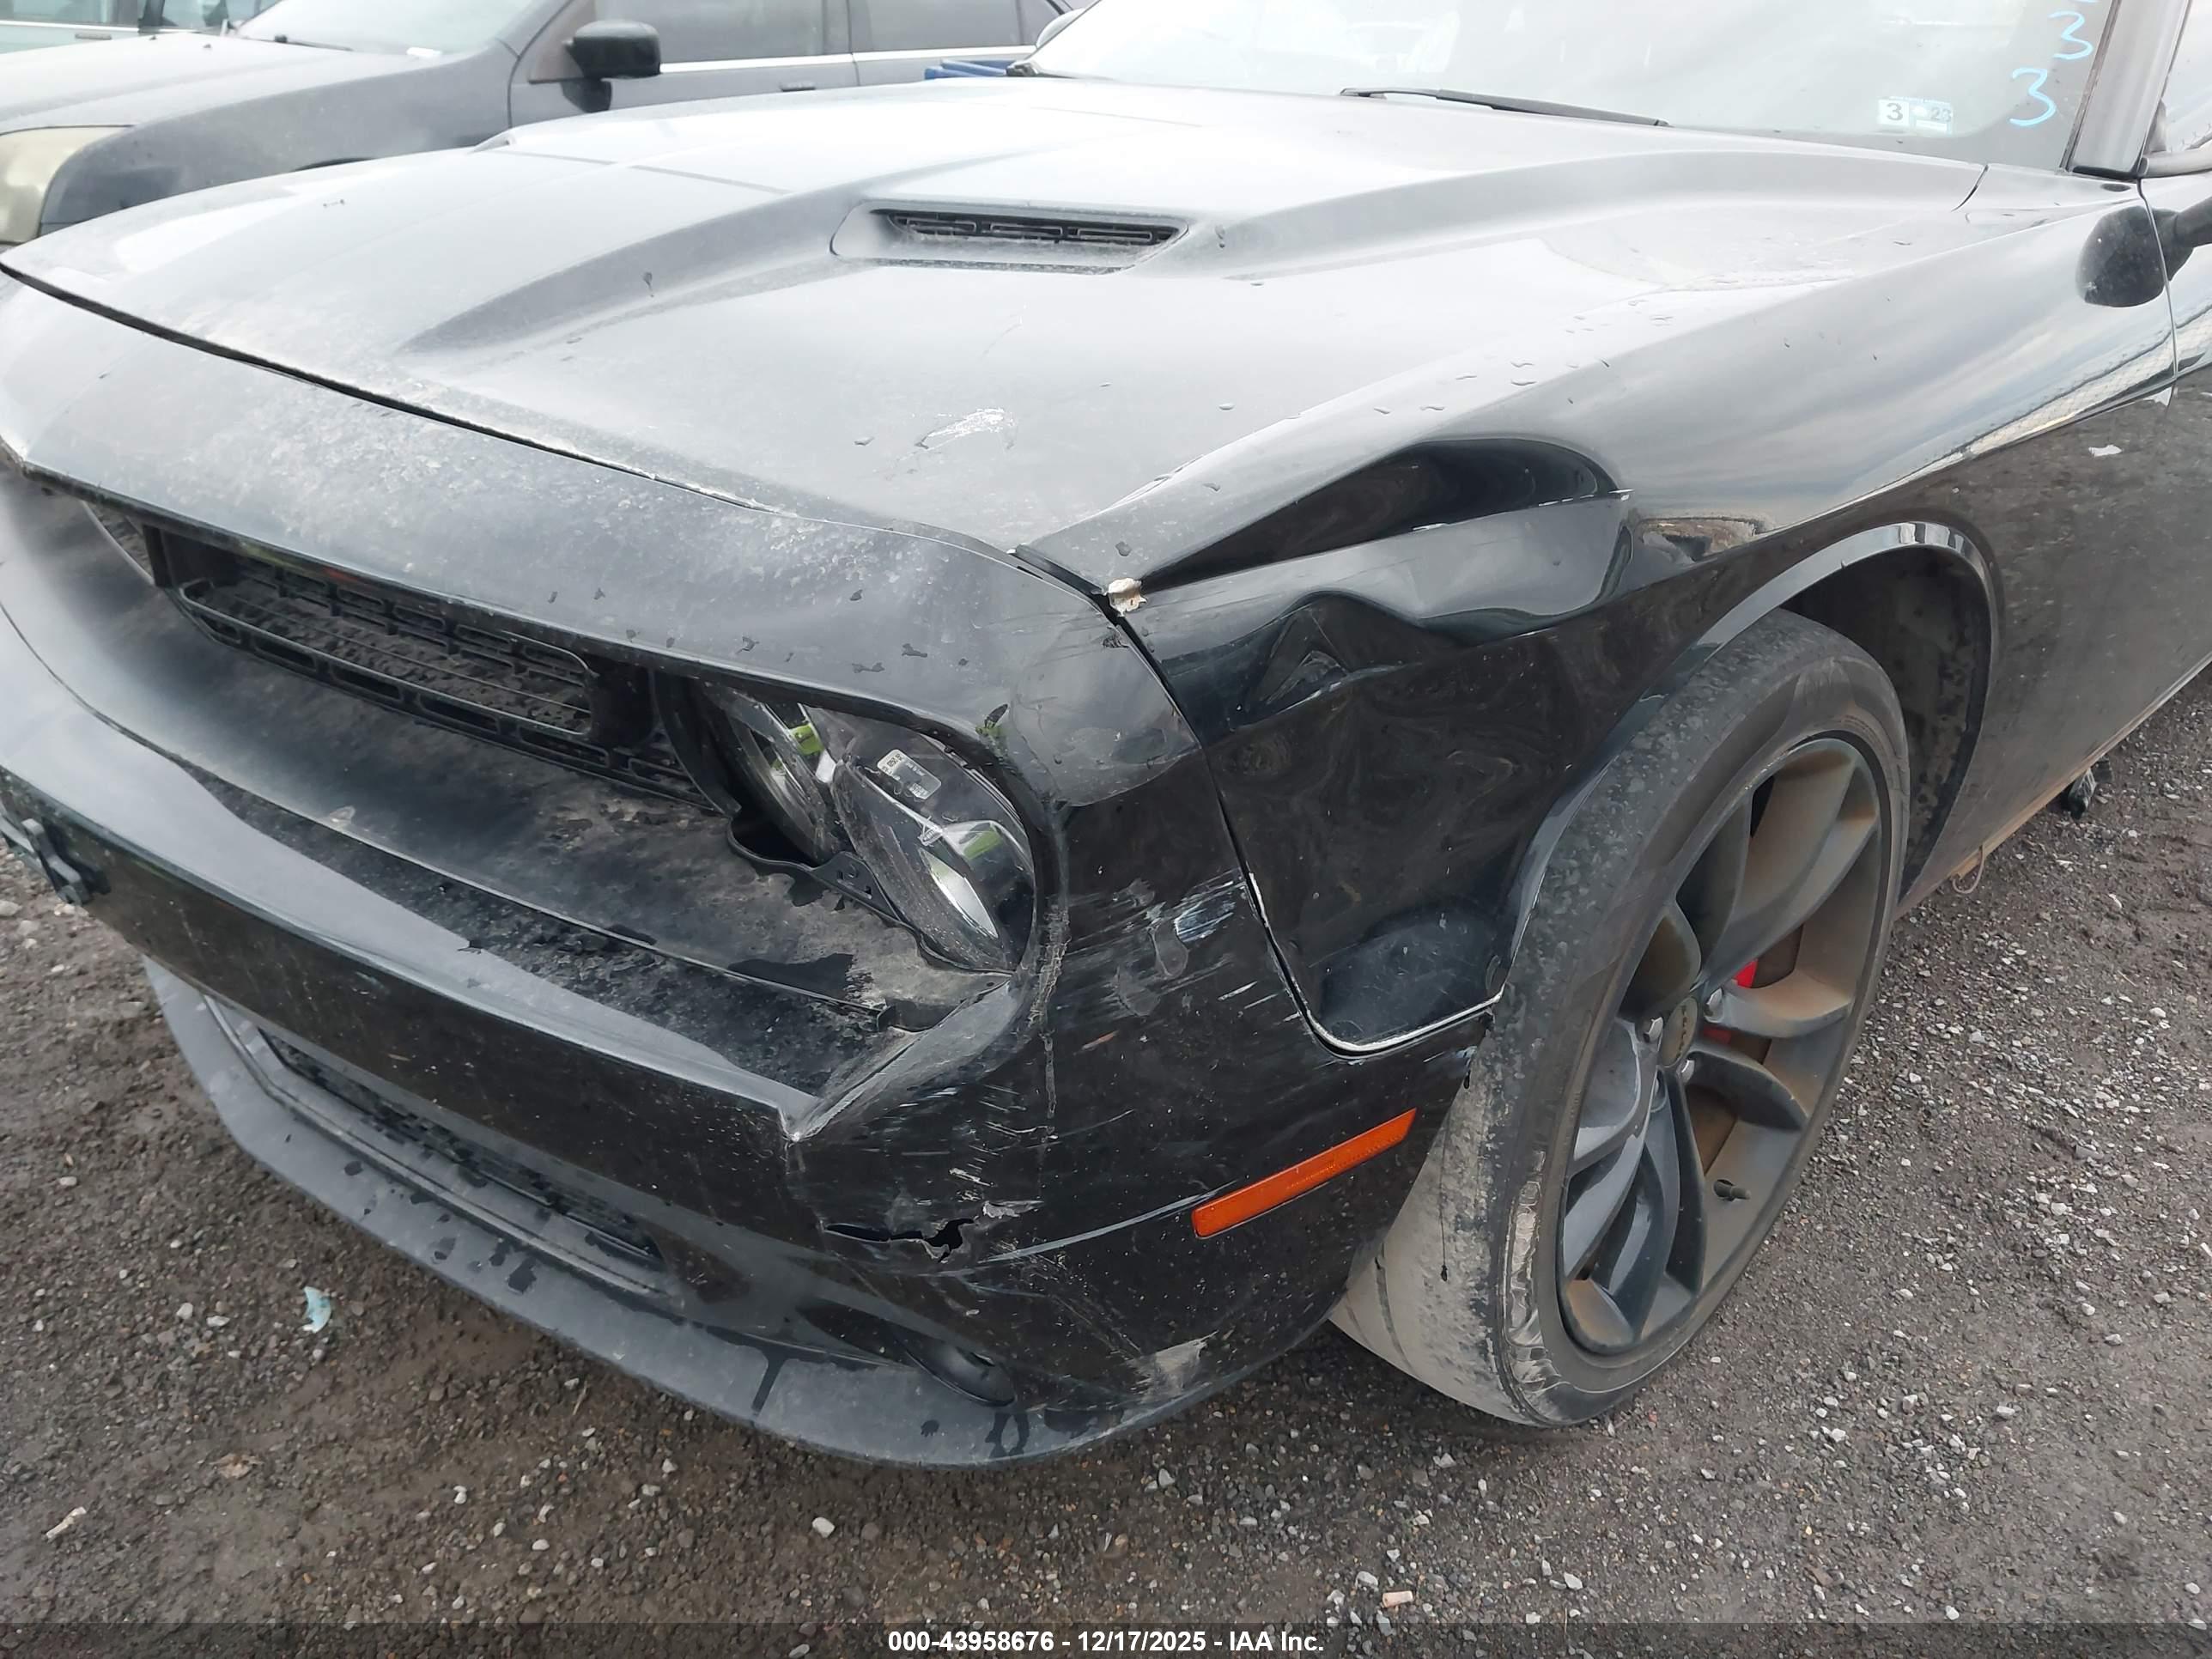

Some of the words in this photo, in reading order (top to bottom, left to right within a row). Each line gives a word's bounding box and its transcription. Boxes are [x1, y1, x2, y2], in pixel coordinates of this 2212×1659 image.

[2047, 10, 2094, 59] 3
[1887, 102, 1904, 121] 3
[2009, 68, 2057, 127] 3
